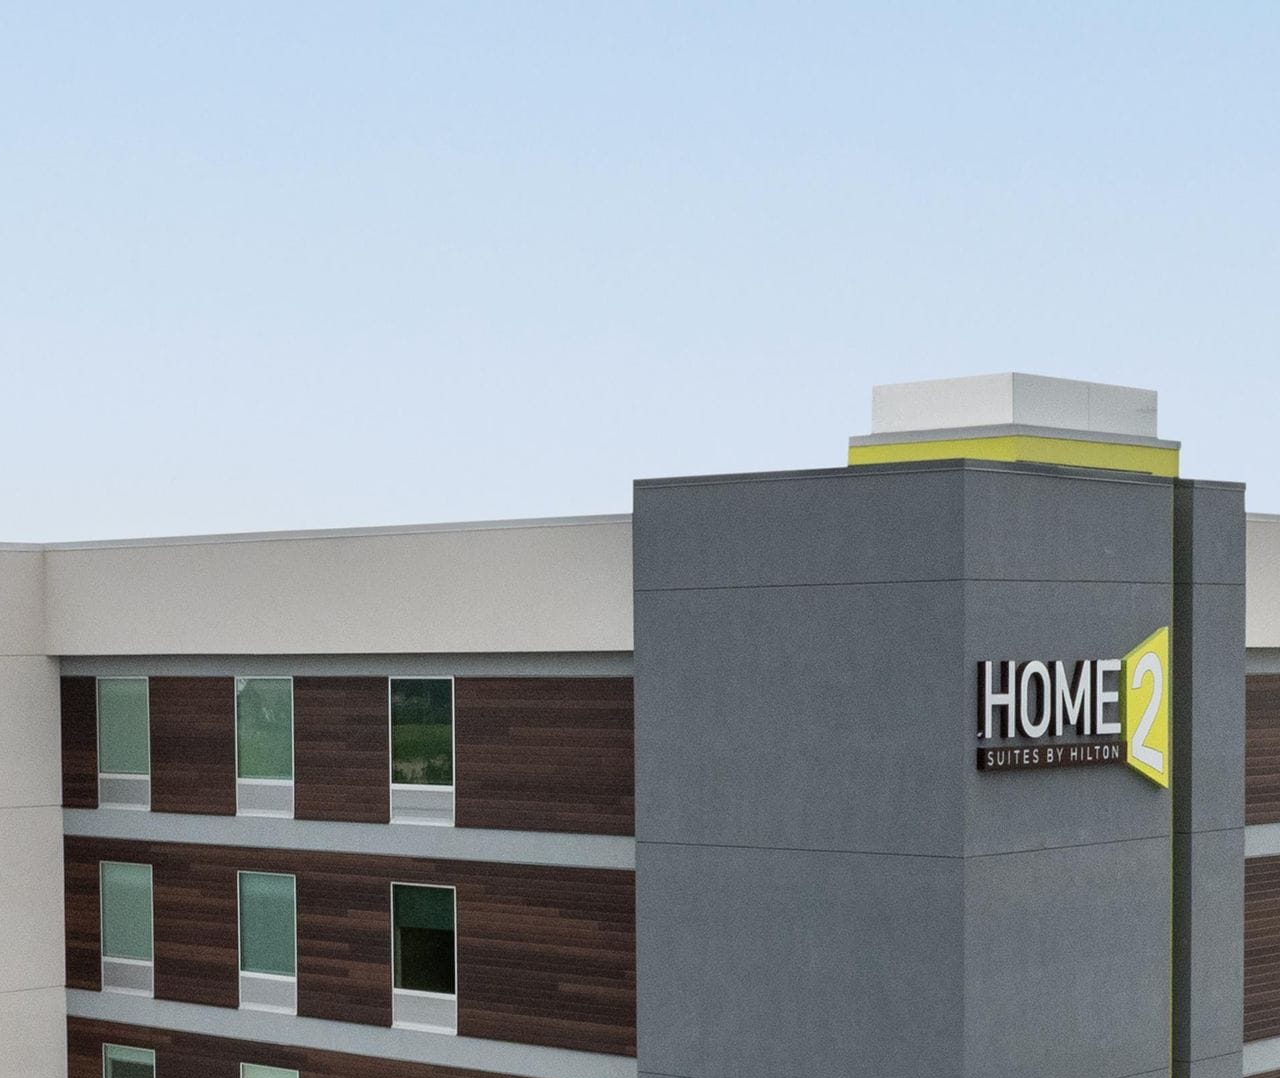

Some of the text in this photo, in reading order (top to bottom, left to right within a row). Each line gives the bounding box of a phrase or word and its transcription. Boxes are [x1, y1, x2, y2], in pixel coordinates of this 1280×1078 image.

[983, 651, 1164, 775] HOME 2
[987, 744, 1120, 766] SUITES BY HILTON
